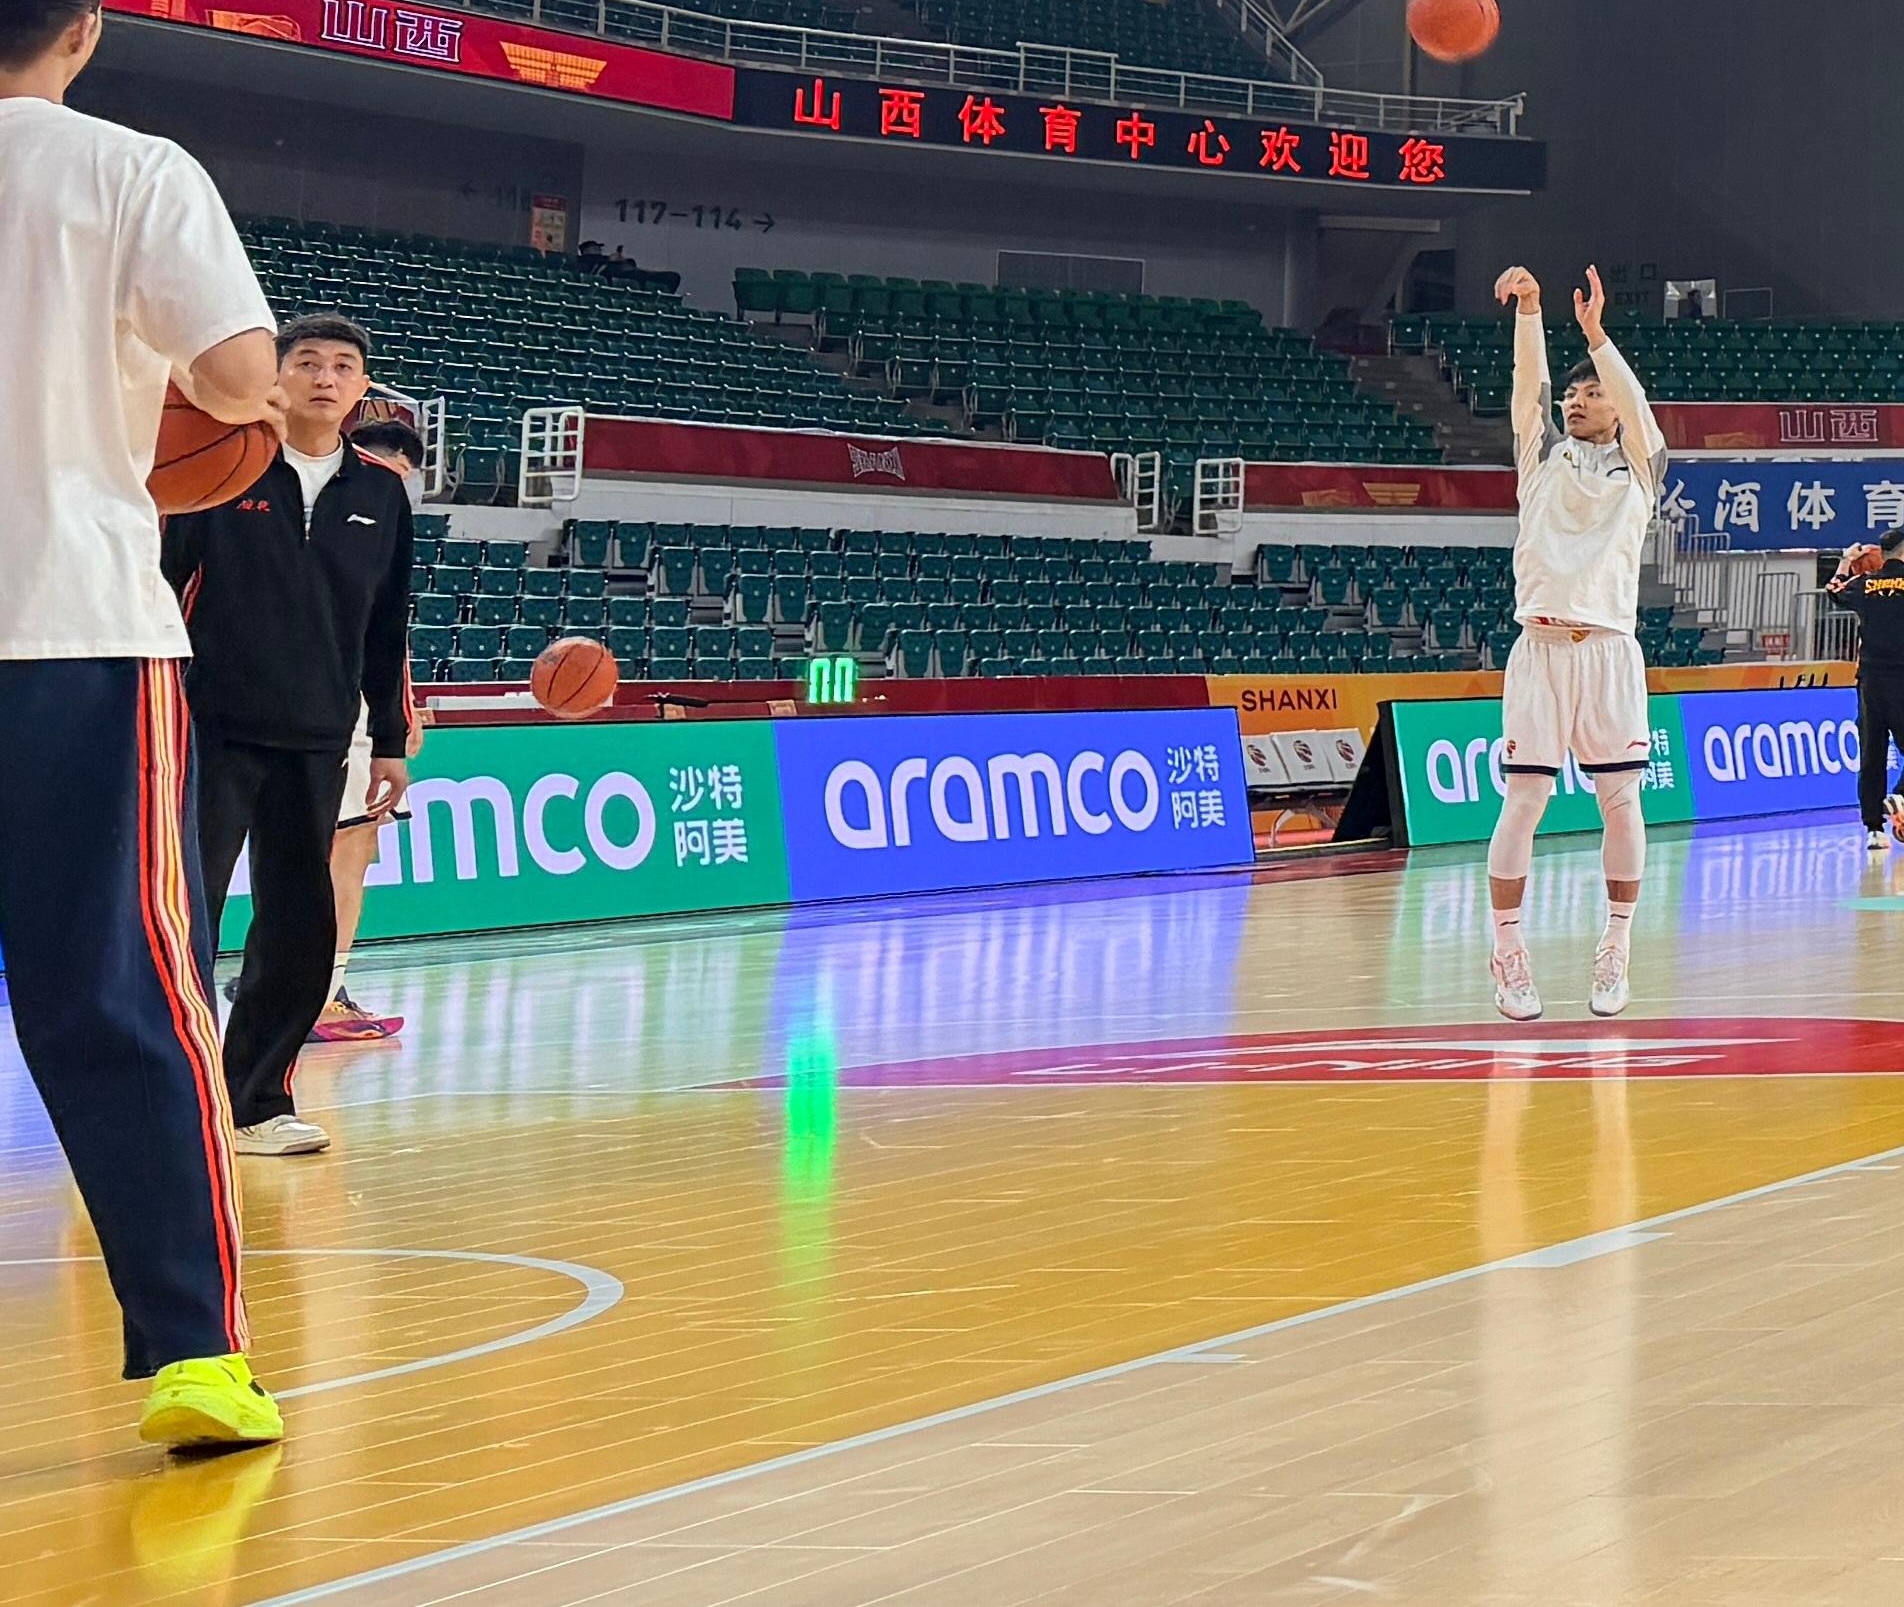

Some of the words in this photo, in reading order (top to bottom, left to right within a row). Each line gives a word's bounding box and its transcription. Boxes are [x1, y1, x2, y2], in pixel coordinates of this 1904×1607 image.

[321, 0, 463, 62] 山西
[794, 78, 1445, 183] 山西体育中心欢迎您
[1779, 409, 1878, 442] 山西
[1241, 688, 1338, 712] SHANXI
[1166, 745, 1220, 786] 沙特
[1704, 719, 1860, 782] aramco
[668, 765, 744, 813] 沙特
[824, 749, 1160, 850] aramco
[1171, 789, 1227, 831] 阿美
[363, 771, 656, 887] mco
[673, 818, 750, 868] 阿美
